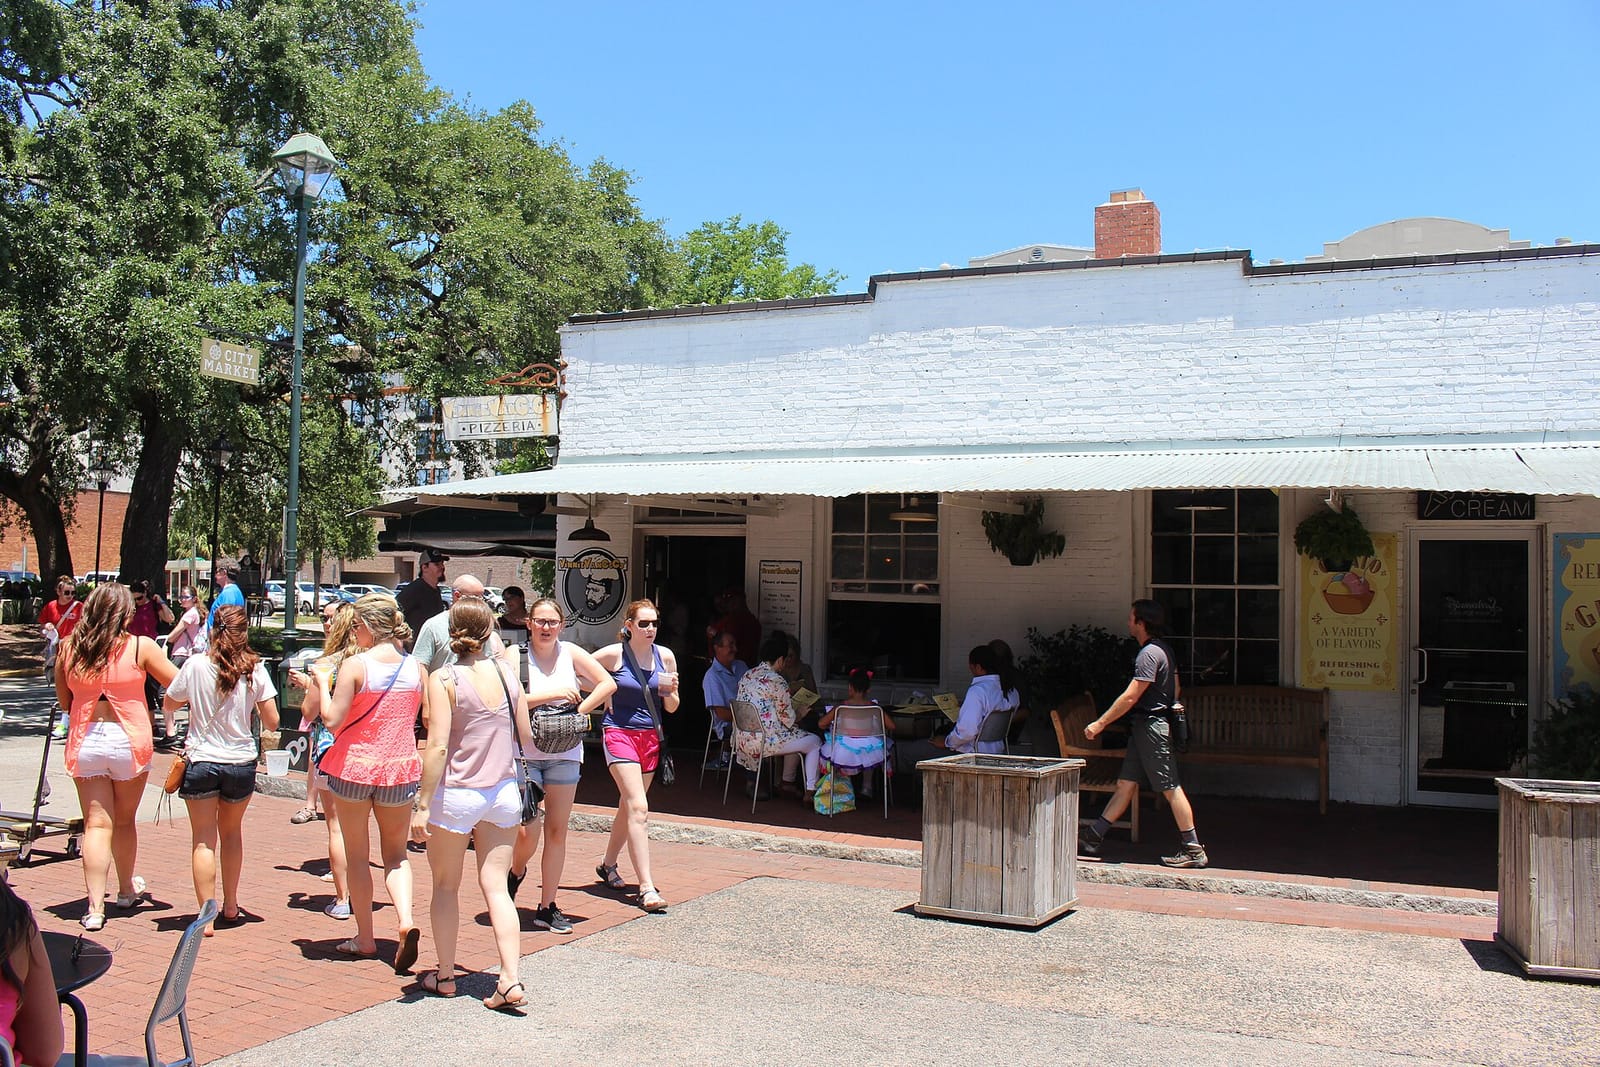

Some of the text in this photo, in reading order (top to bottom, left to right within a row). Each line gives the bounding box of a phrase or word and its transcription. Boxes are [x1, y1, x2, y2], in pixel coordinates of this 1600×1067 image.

[225, 350, 253, 366] CITY
[204, 358, 257, 380] MARKET
[469, 420, 536, 433] PIZZERIA
[1451, 499, 1531, 518] CREAM
[1571, 563, 1600, 579] RE
[1320, 627, 1377, 638] A VARIETY
[1316, 638, 1381, 649] OF FLAVORS
[1319, 660, 1381, 670] REFRESHING
[1340, 670, 1367, 678] COOL
